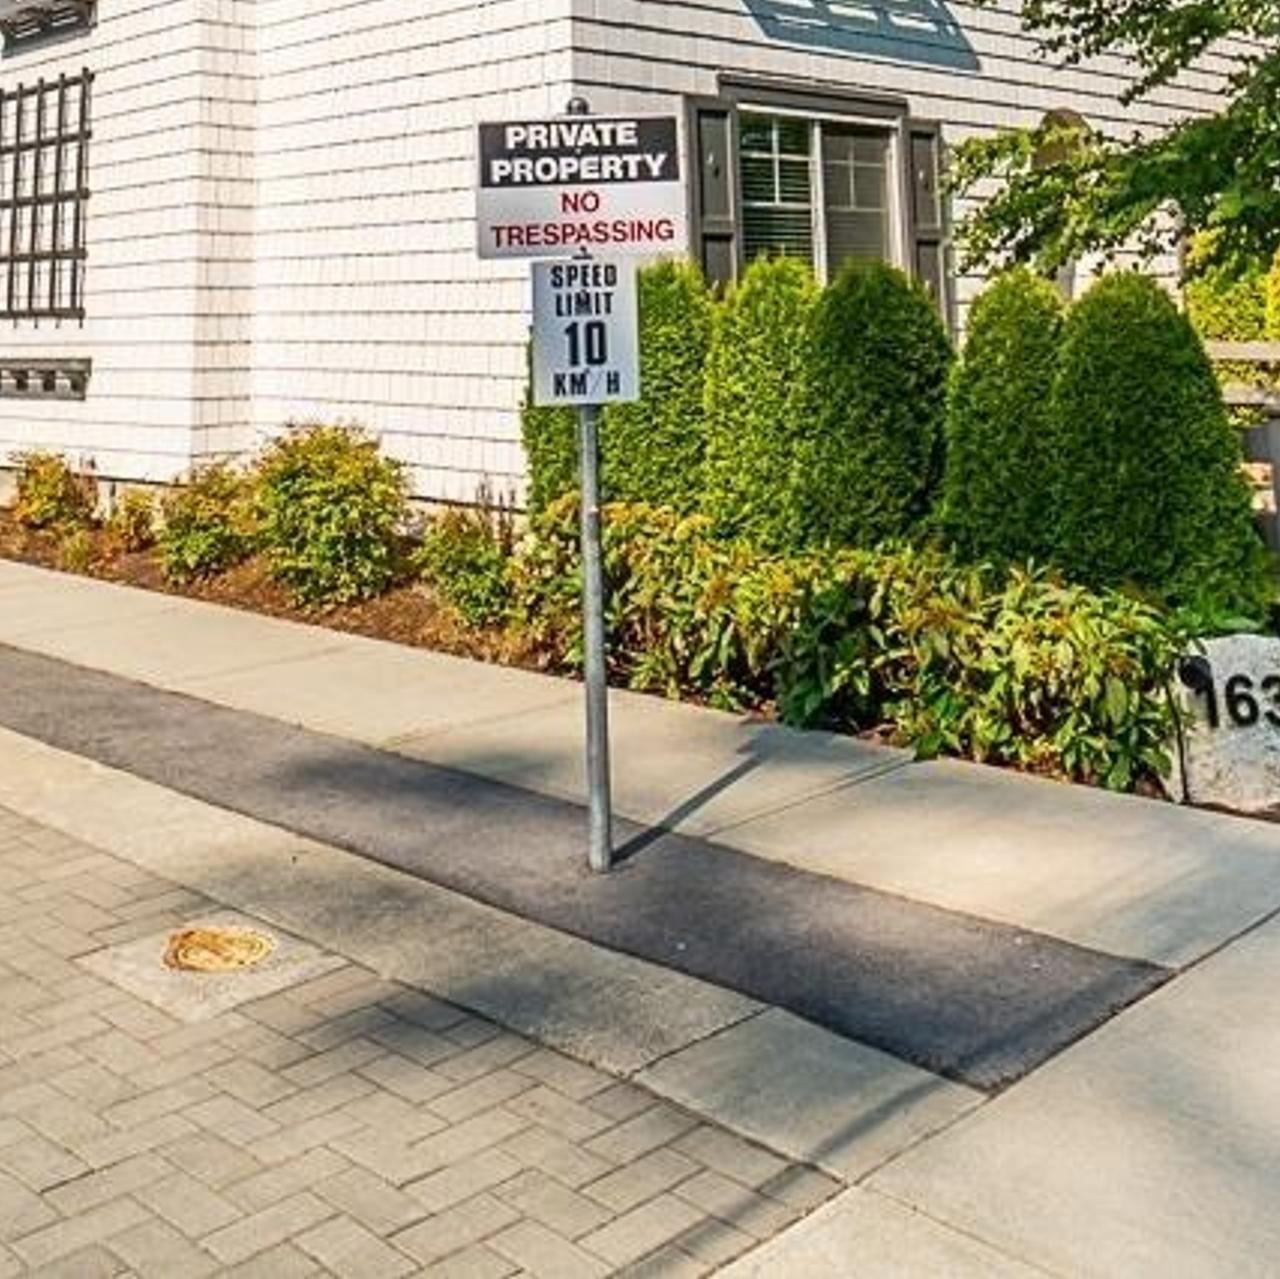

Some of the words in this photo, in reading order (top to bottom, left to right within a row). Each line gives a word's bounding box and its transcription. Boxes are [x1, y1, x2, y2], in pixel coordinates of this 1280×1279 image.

[504, 121, 639, 149] PRIVATE
[490, 152, 668, 183] PROPERTY
[561, 192, 600, 212] NO
[490, 219, 675, 247] TRESPASSING
[550, 264, 618, 289] SPEED
[555, 291, 615, 317] LIMIT
[564, 320, 608, 367] 10
